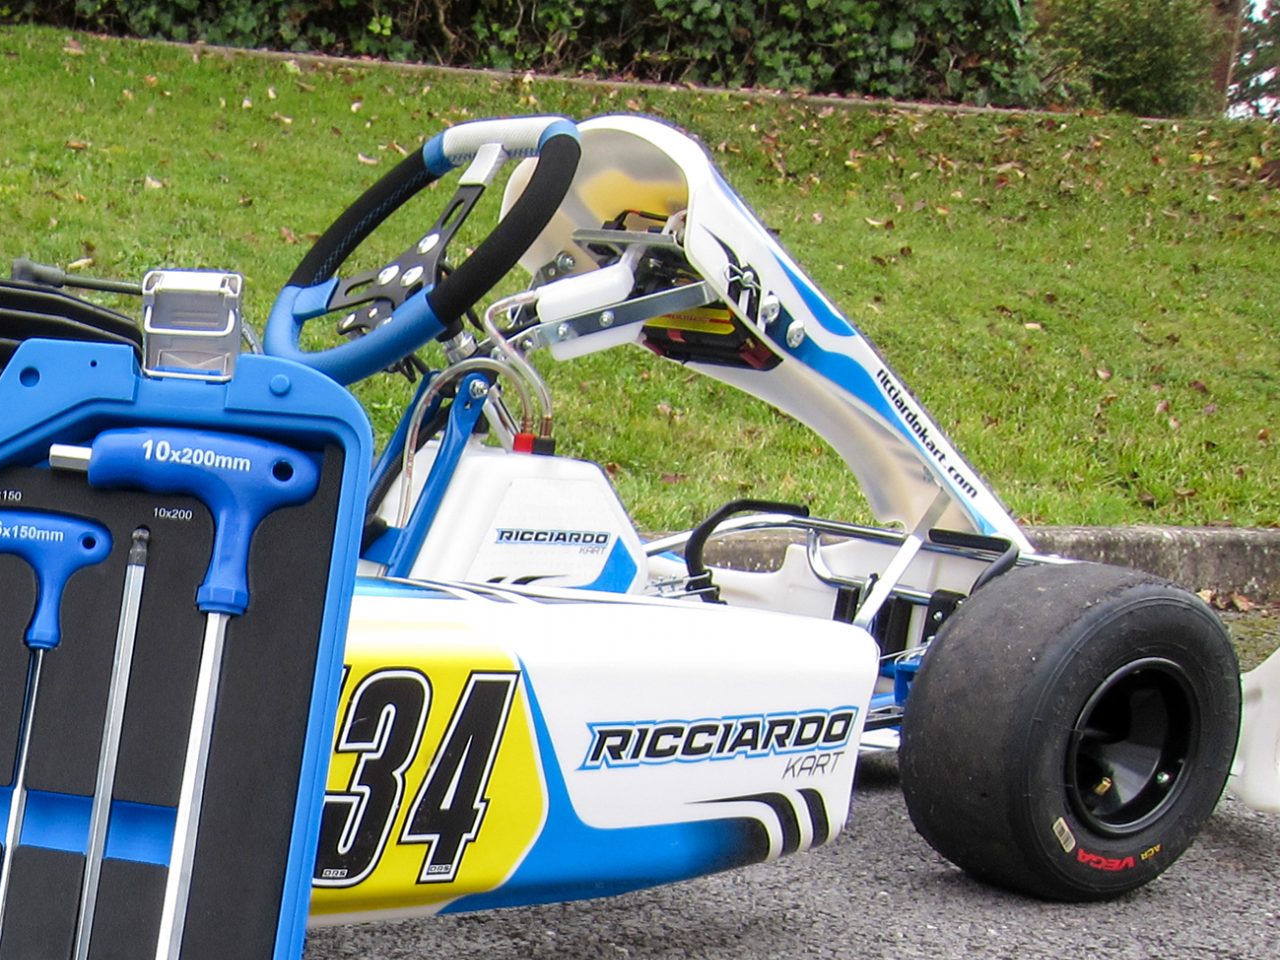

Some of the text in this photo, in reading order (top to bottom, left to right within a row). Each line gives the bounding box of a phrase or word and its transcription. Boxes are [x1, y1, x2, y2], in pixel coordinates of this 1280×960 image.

[876, 368, 978, 498] ricciardokart.com
[141, 438, 252, 472] 10x200mm
[154, 507, 193, 520] 10x200
[496, 528, 610, 546] RICCIARDO
[578, 545, 608, 556] KART
[584, 710, 857, 767] RICCIARDO
[311, 664, 521, 888] 34
[781, 750, 845, 781] KART
[1076, 848, 1137, 871] VEGA
